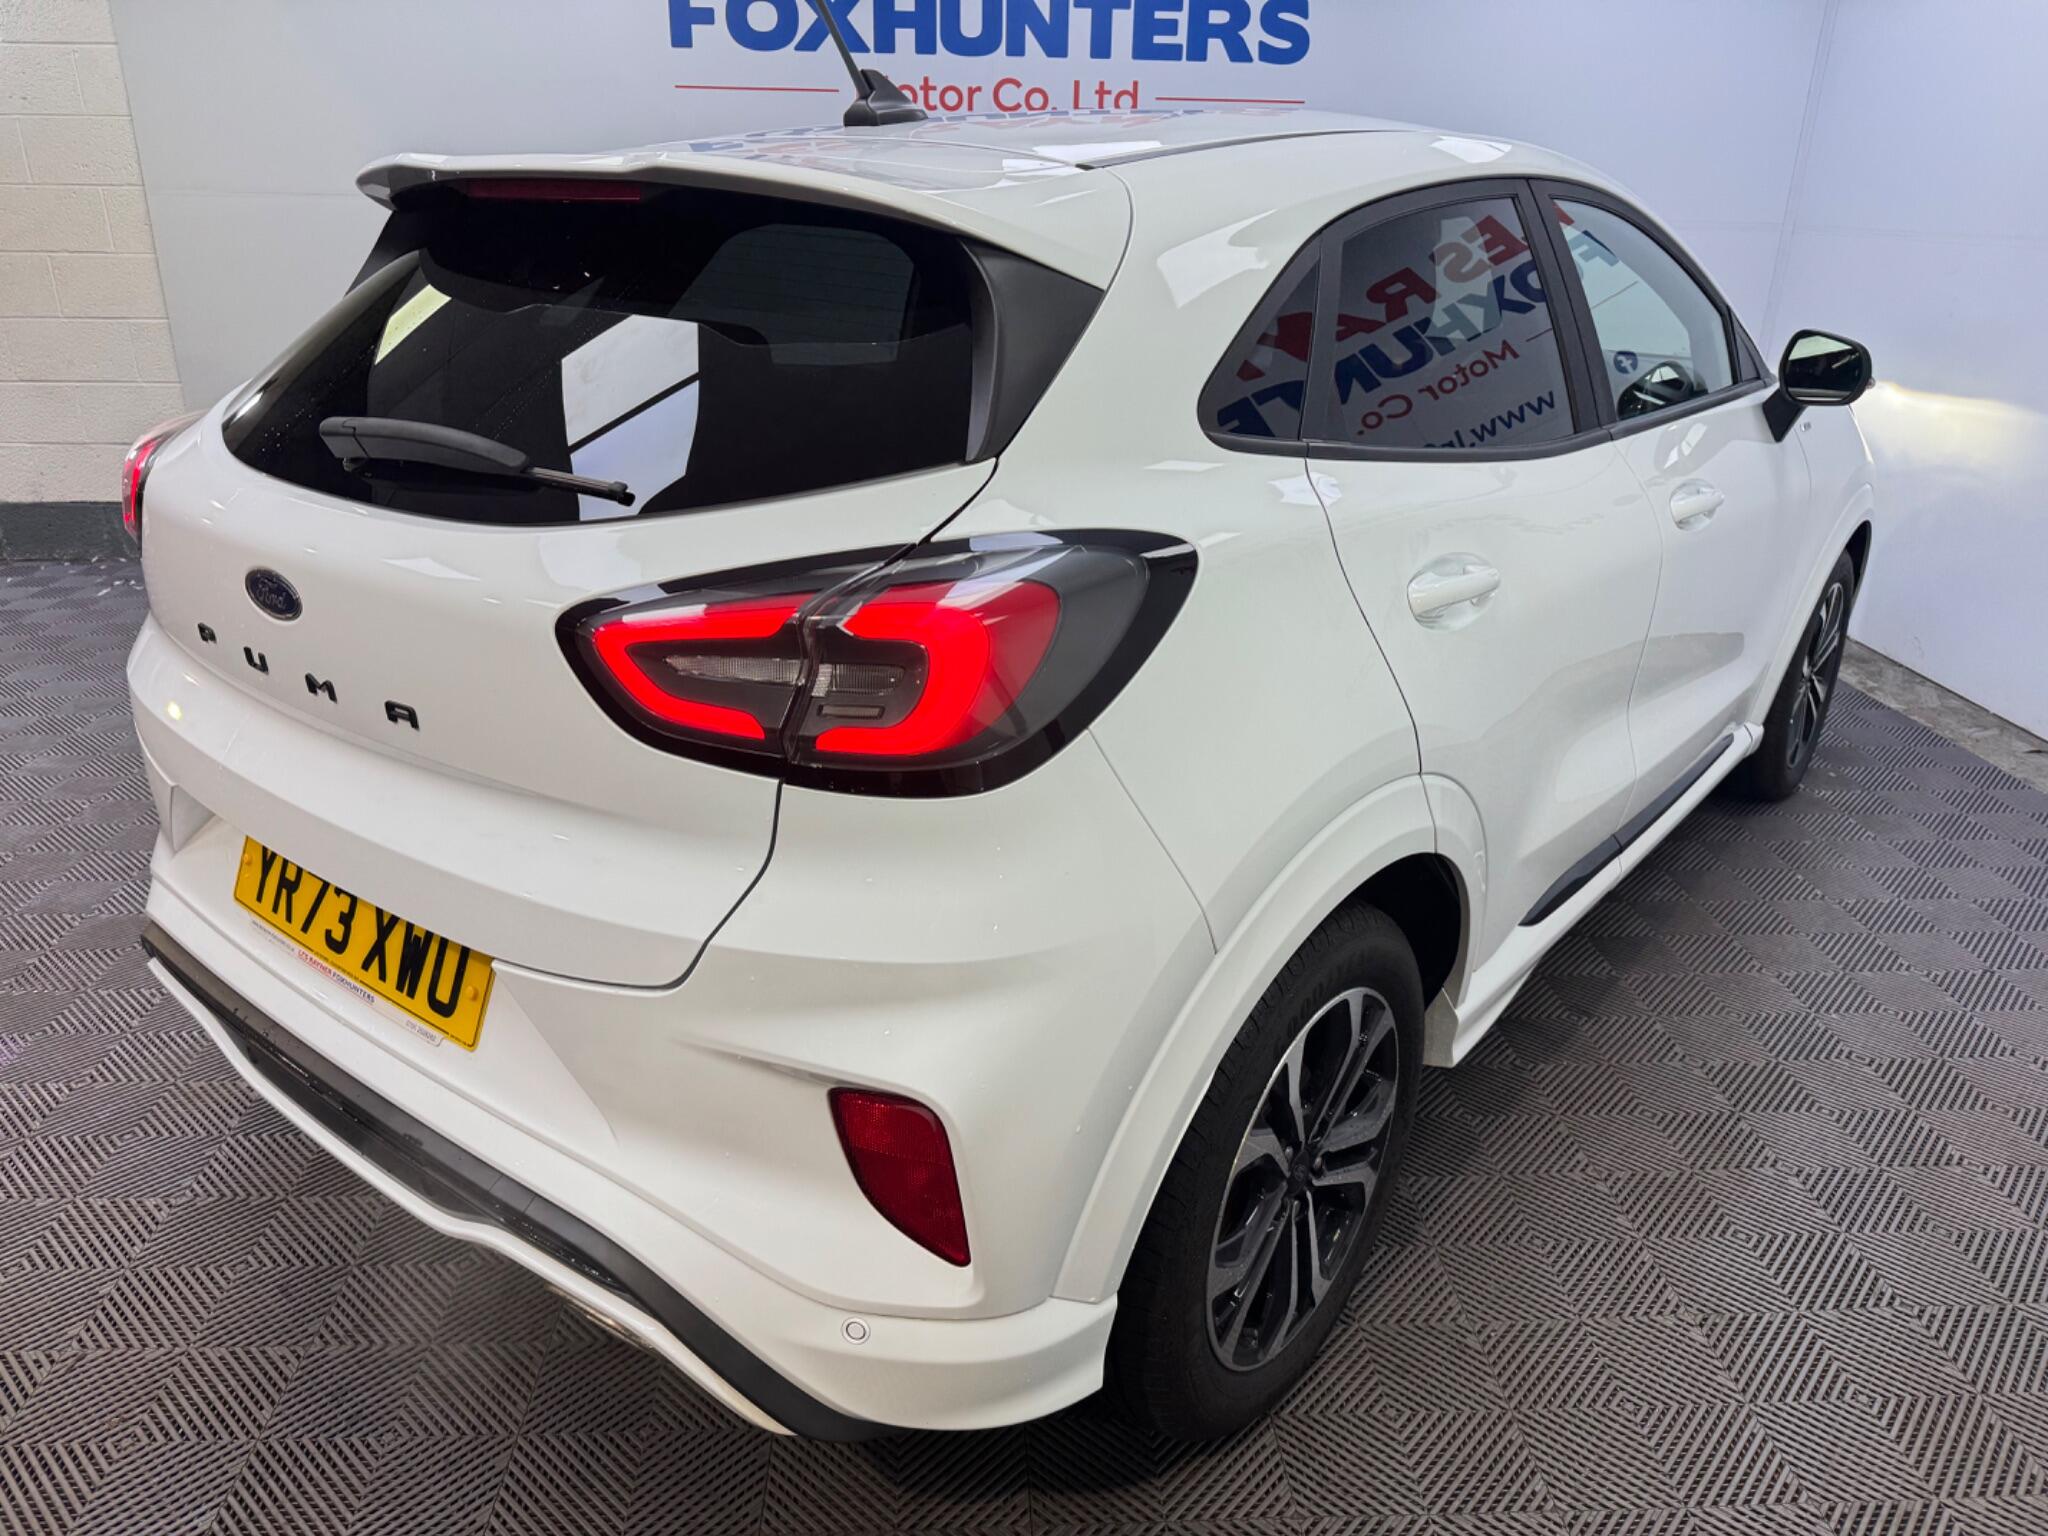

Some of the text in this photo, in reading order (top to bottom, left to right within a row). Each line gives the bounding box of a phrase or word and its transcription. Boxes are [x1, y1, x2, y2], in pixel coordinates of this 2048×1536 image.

[669, 0, 1310, 65] FOXHUNTERS
[886, 75, 982, 111] otor
[992, 77, 1058, 112] Co.
[197, 622, 420, 731] PUMA
[256, 845, 358, 955] YR73
